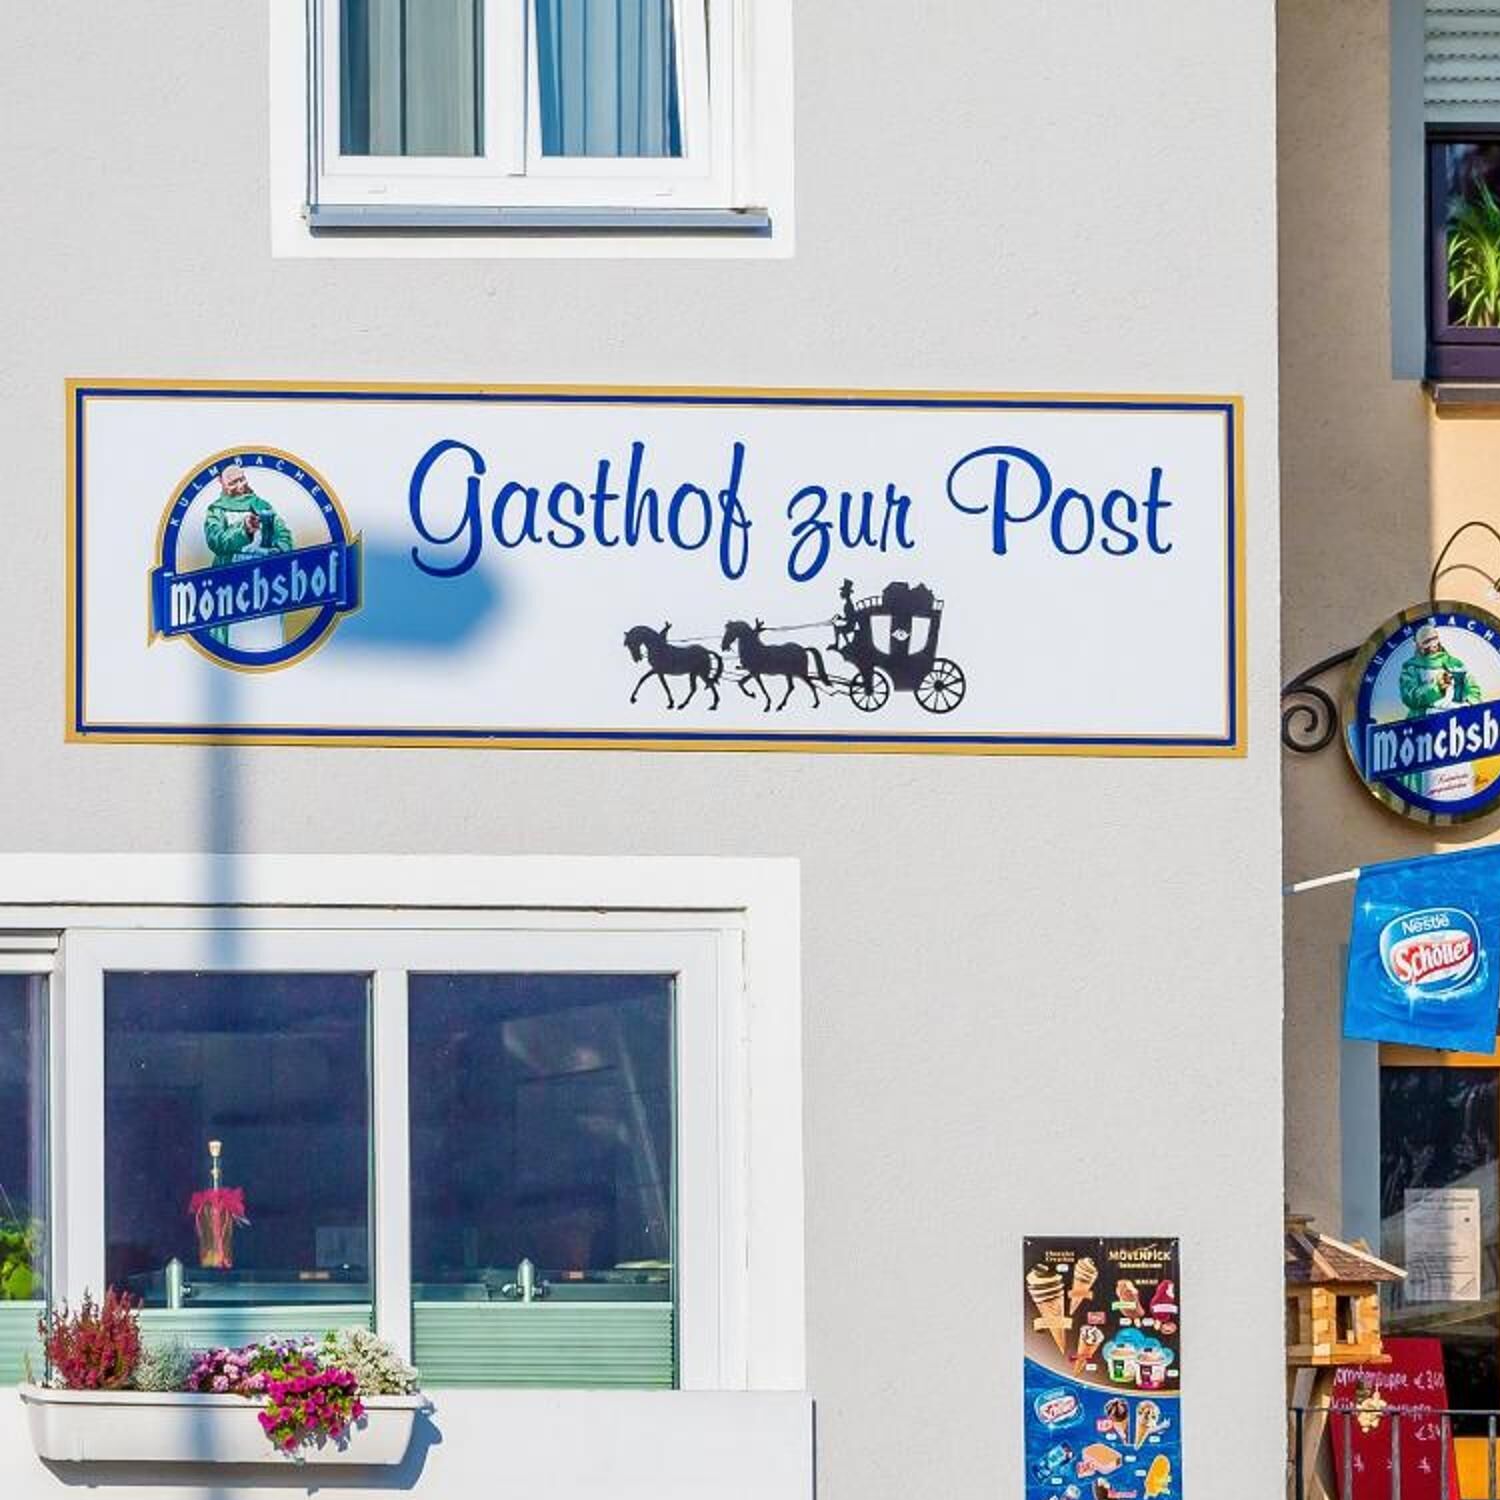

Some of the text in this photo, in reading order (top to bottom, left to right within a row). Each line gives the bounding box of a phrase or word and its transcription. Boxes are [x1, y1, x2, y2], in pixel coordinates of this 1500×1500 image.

[170, 455, 333, 526] KULMBACHER
[409, 440, 1173, 582] Gasthof zur Post
[171, 551, 339, 627] Mönchshof
